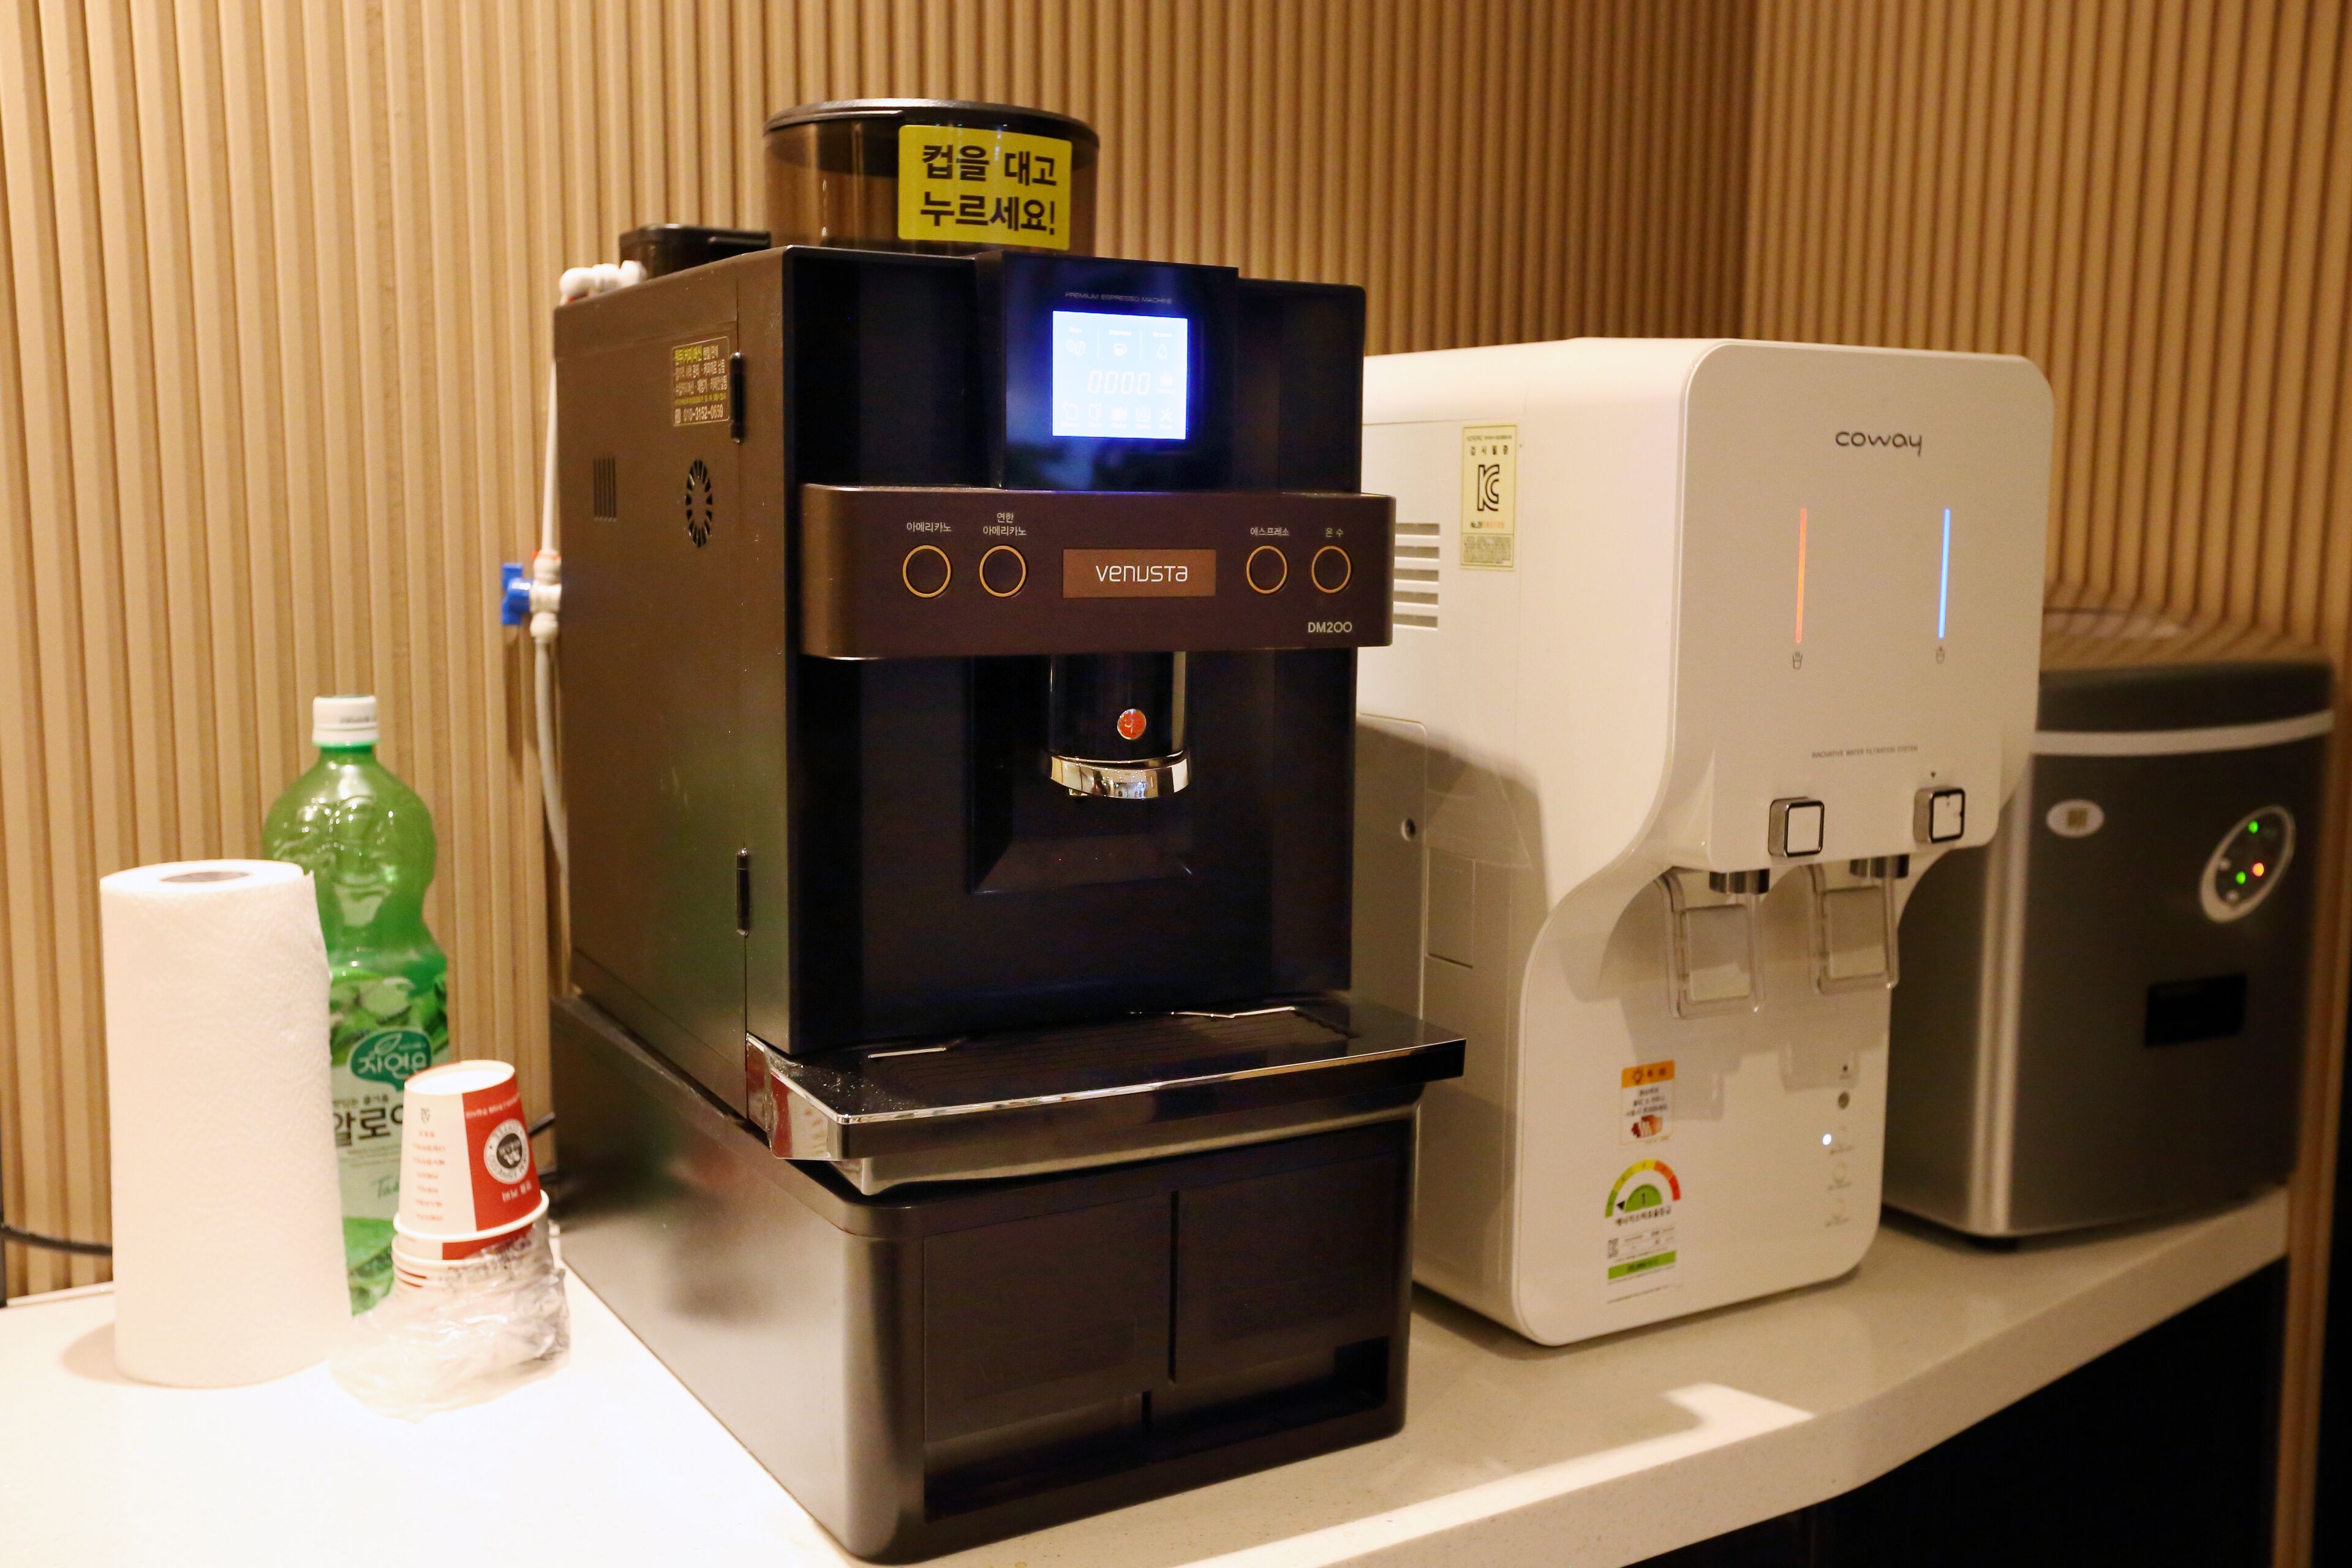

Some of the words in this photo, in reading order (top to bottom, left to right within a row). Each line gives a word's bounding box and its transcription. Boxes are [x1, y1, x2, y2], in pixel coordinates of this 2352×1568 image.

[922, 145, 990, 182] 컵을
[1004, 151, 1057, 186] 대고
[921, 191, 1055, 236] 누르세요!
[1101, 293, 1140, 302] ESPRESSO
[1835, 431, 1923, 457] coway
[997, 512, 1014, 523] 연한
[907, 522, 952, 532] 아메리카노
[983, 526, 1027, 536] 아메리카노
[1250, 527, 1289, 537] 에스프레소
[1308, 622, 1352, 633] DM200
[333, 1104, 403, 1147] 알로
